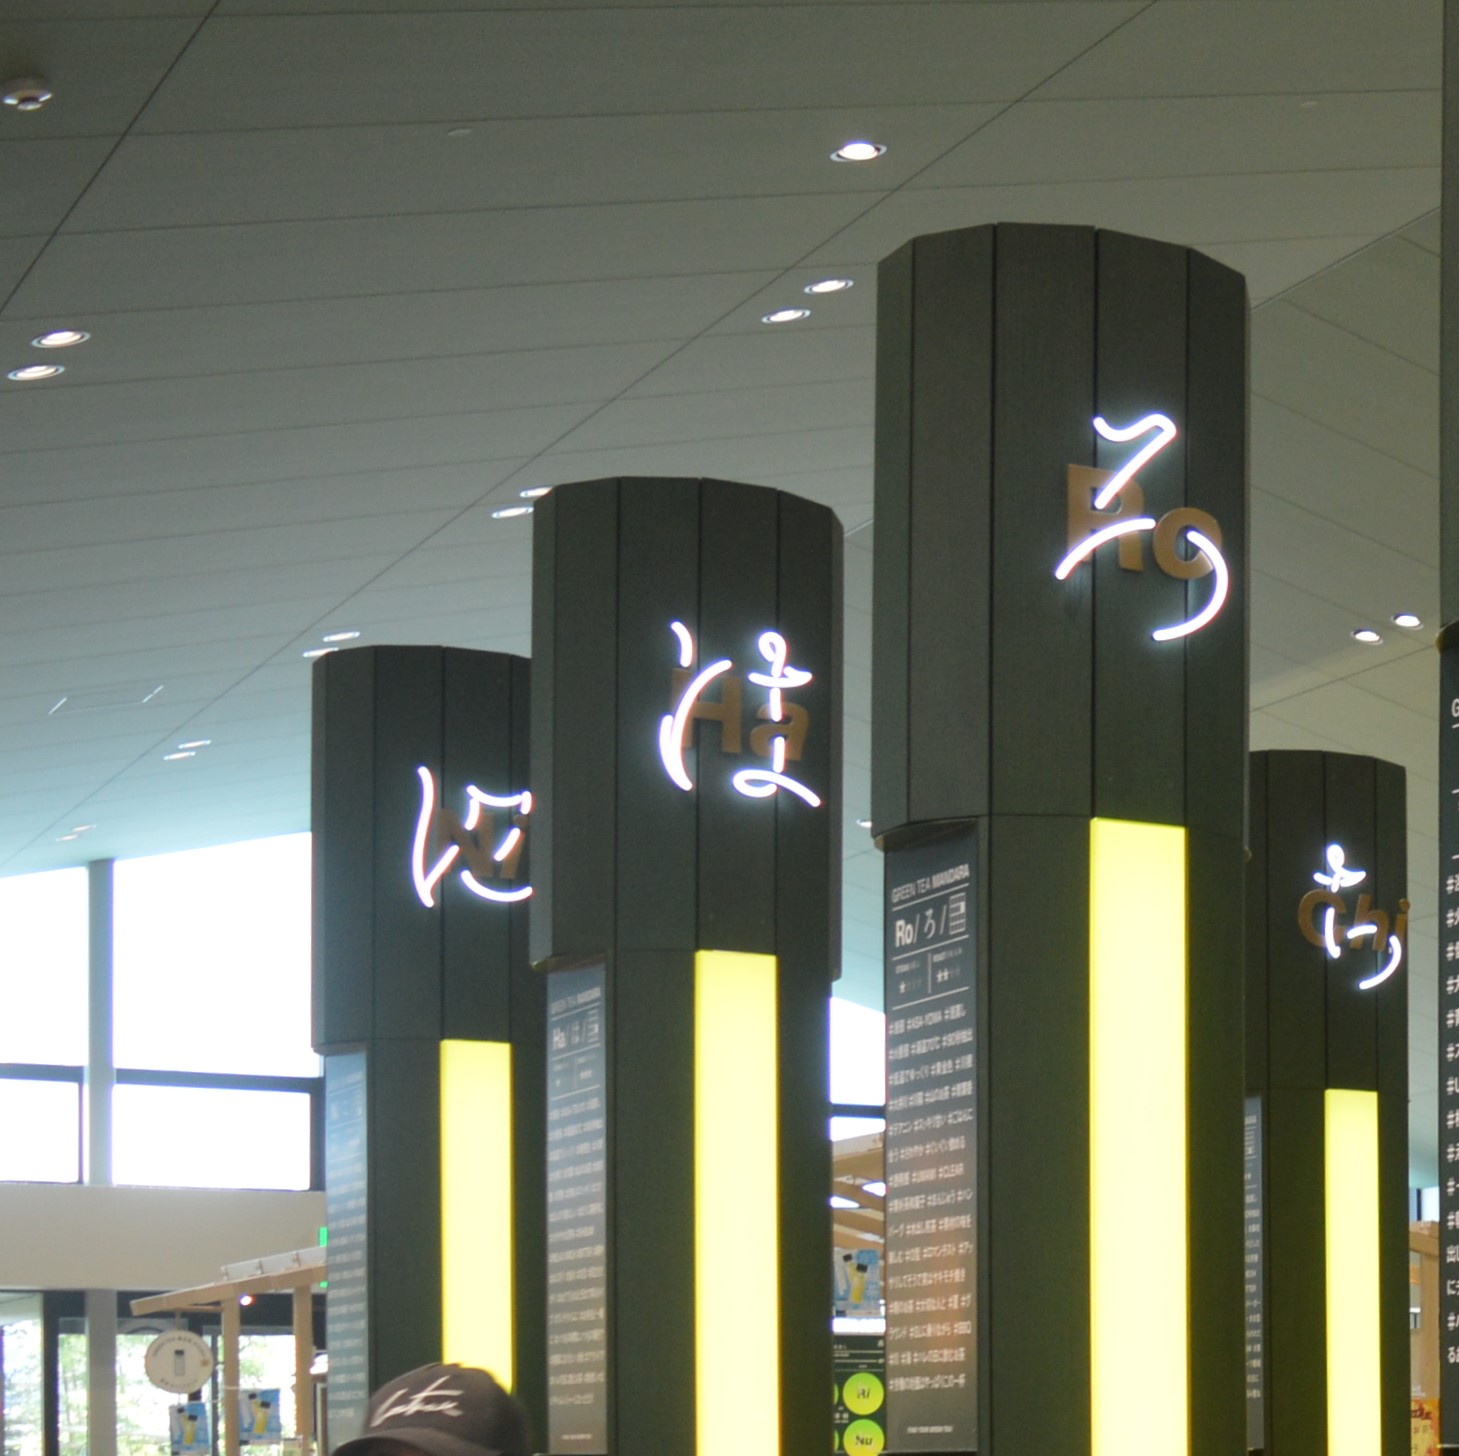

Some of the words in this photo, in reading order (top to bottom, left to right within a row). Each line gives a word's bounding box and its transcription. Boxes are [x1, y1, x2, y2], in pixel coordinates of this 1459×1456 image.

[1054, 413, 1230, 642] ろ
[1066, 463, 1223, 581] Ro
[658, 620, 821, 808] は
[411, 764, 534, 909] に
